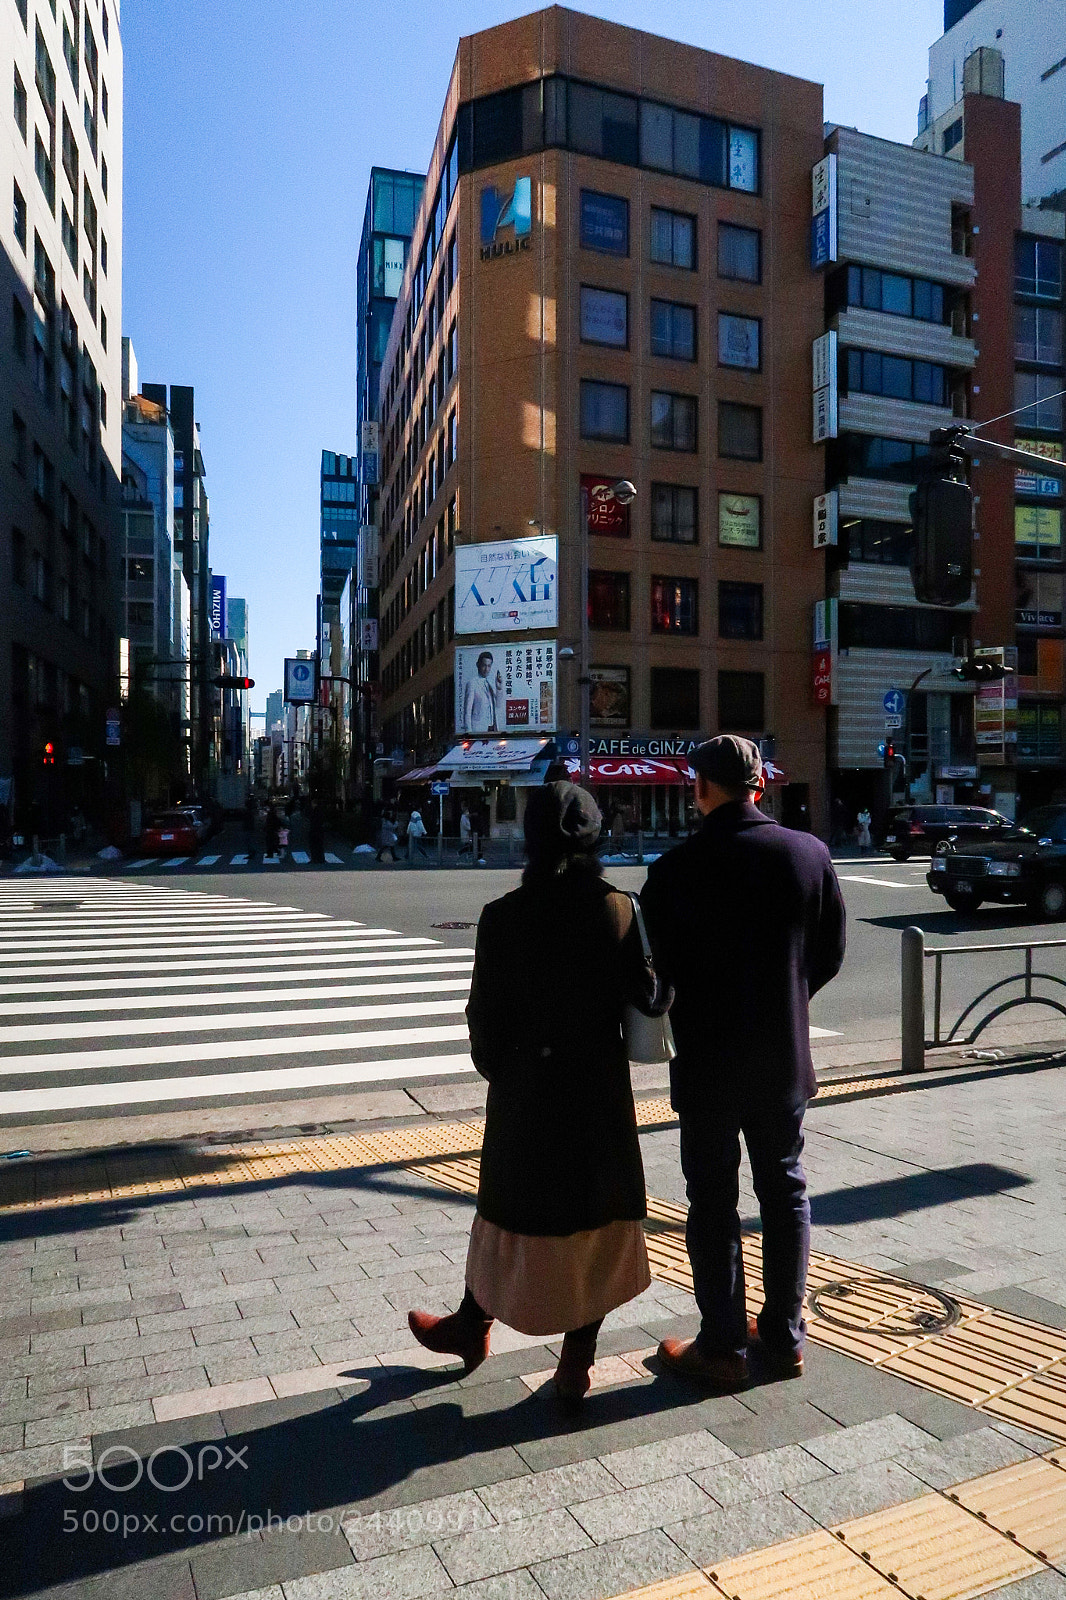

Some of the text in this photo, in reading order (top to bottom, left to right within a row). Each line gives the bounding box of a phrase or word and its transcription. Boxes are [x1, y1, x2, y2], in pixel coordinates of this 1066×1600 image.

[481, 238, 530, 261] HULIC
[212, 589, 221, 629] MIZUHO
[589, 738, 696, 756] CAFE de GINZA
[597, 763, 657, 776] CAFE
